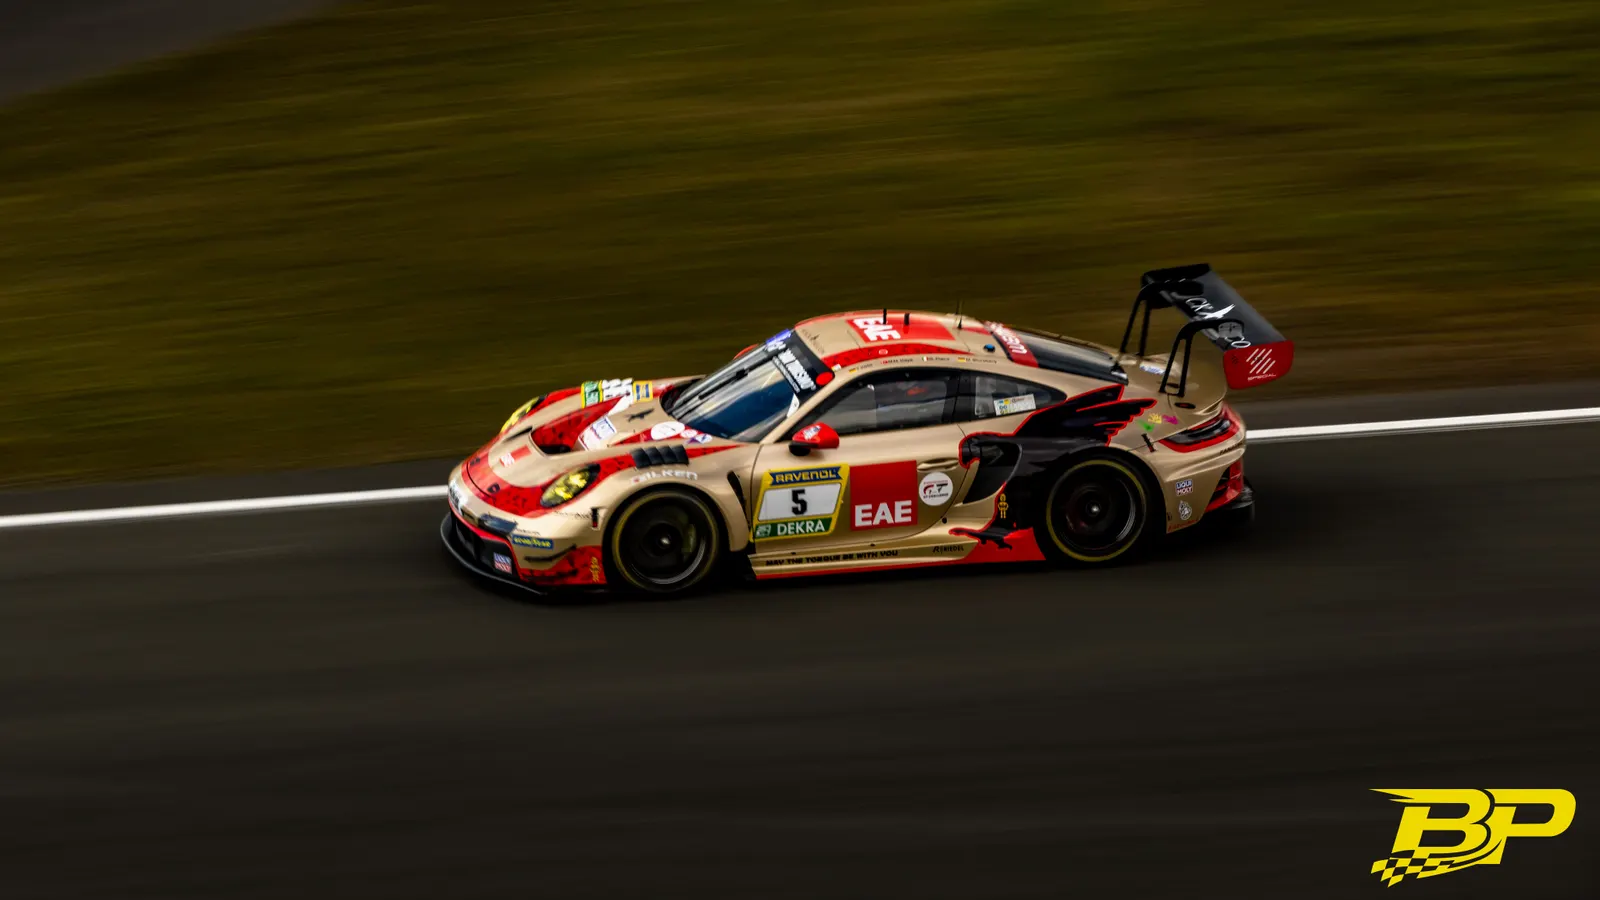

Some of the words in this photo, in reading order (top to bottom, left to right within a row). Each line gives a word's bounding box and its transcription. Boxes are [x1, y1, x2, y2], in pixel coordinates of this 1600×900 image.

[1176, 480, 1193, 489] LIQUI
[1176, 487, 1194, 496] MOLY
[791, 488, 808, 515] 5
[855, 500, 912, 527] EAE
[777, 519, 826, 535] DEKRA
[765, 559, 784, 567] MAY
[787, 557, 803, 565] THE
[805, 555, 840, 564] TORQUE
[842, 553, 854, 561] BE
[856, 552, 878, 560] WITH
[880, 550, 899, 558] YOU
